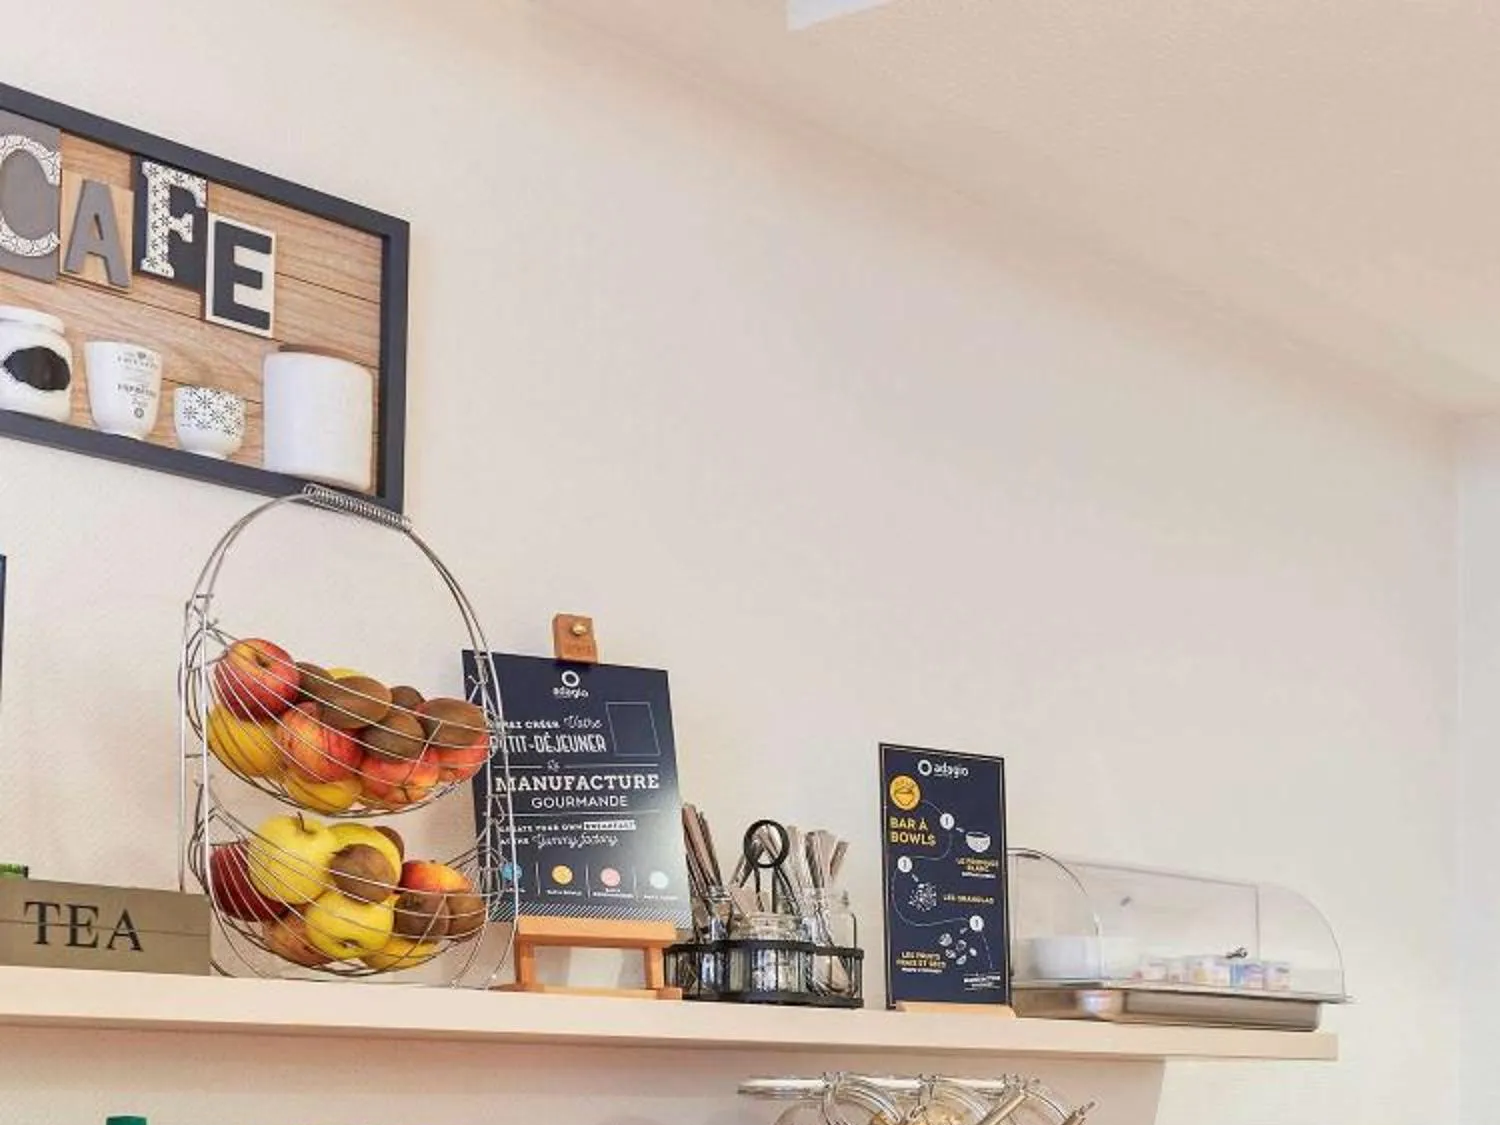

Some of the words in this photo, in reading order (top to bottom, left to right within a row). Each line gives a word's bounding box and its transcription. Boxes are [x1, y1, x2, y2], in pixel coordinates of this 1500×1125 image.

[933, 762, 969, 779] adagio
[496, 774, 659, 793] MANUFACTURE
[531, 796, 628, 809] GOURMANDE
[890, 816, 916, 830] BAR
[891, 831, 936, 846] BOWLS
[24, 901, 144, 952] TEA
